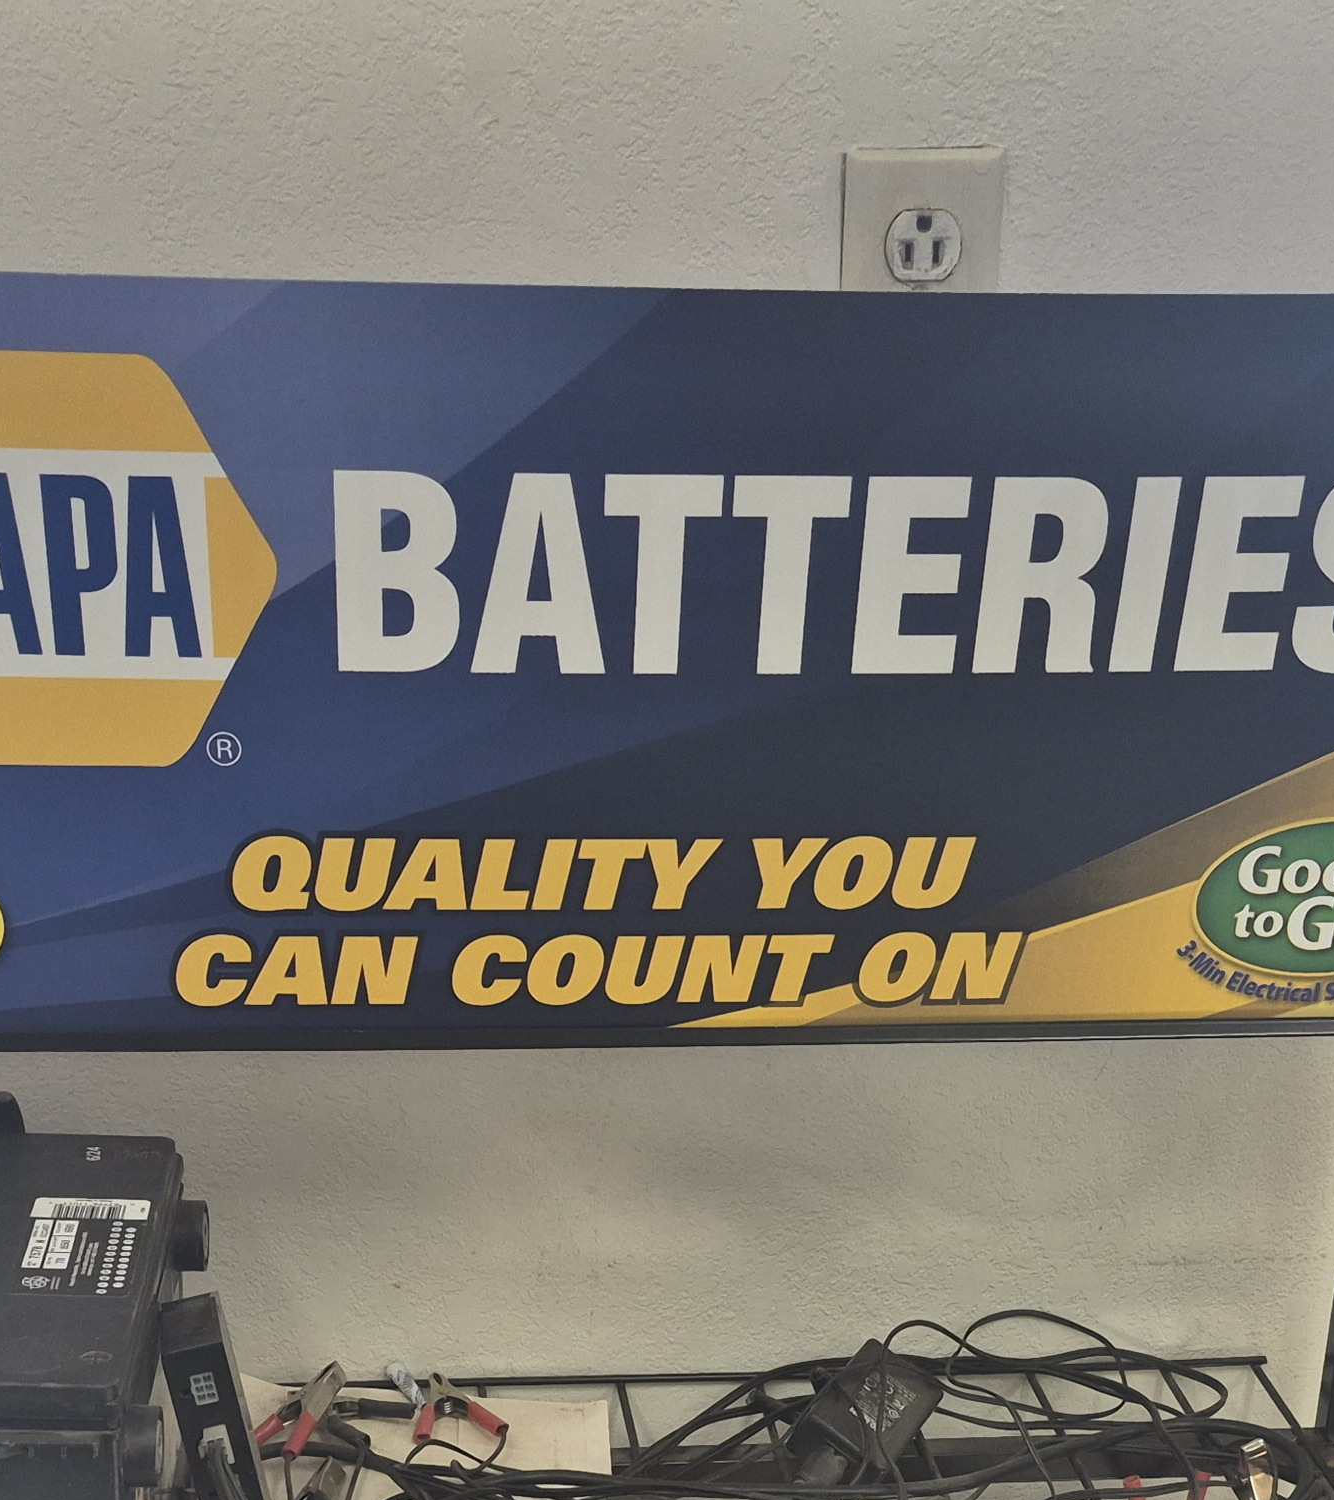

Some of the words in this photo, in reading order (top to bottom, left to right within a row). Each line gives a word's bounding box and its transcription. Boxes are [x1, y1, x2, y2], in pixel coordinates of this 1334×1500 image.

[231, 835, 725, 912] QUALITY
[752, 835, 978, 912] YOU
[1233, 904, 1284, 938] to
[174, 933, 419, 1007] CAN
[451, 933, 833, 1007] COUNT
[857, 931, 1024, 1002] ON
[1176, 939, 1225, 985] 3-Min
[1225, 971, 1321, 1002] Electrical
